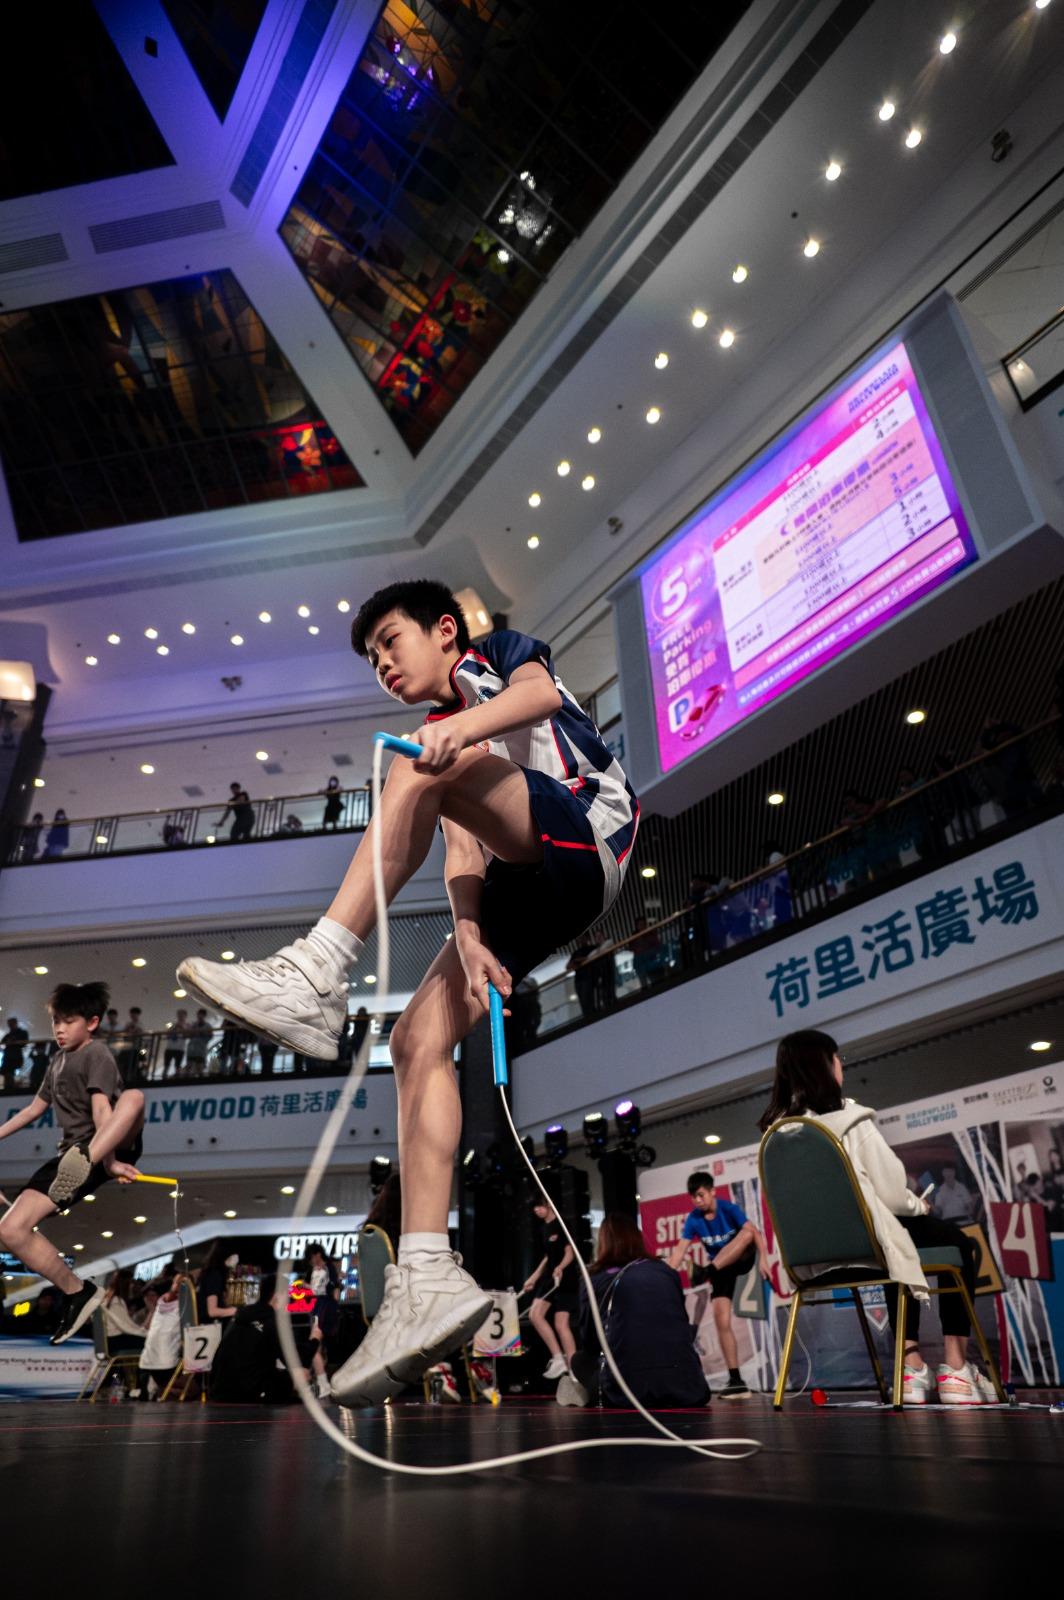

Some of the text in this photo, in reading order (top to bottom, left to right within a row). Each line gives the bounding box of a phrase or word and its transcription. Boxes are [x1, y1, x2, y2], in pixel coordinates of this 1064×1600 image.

[659, 567, 689, 617] 5
[663, 620, 713, 664] Parking
[674, 698, 690, 726] P
[765, 860, 1040, 1017] 荷里活廣場
[906, 1109, 958, 1130] HOLLYWOOD
[1002, 1202, 1040, 1279] 4
[490, 1308, 504, 1340] 3
[193, 1337, 209, 1361] 2
